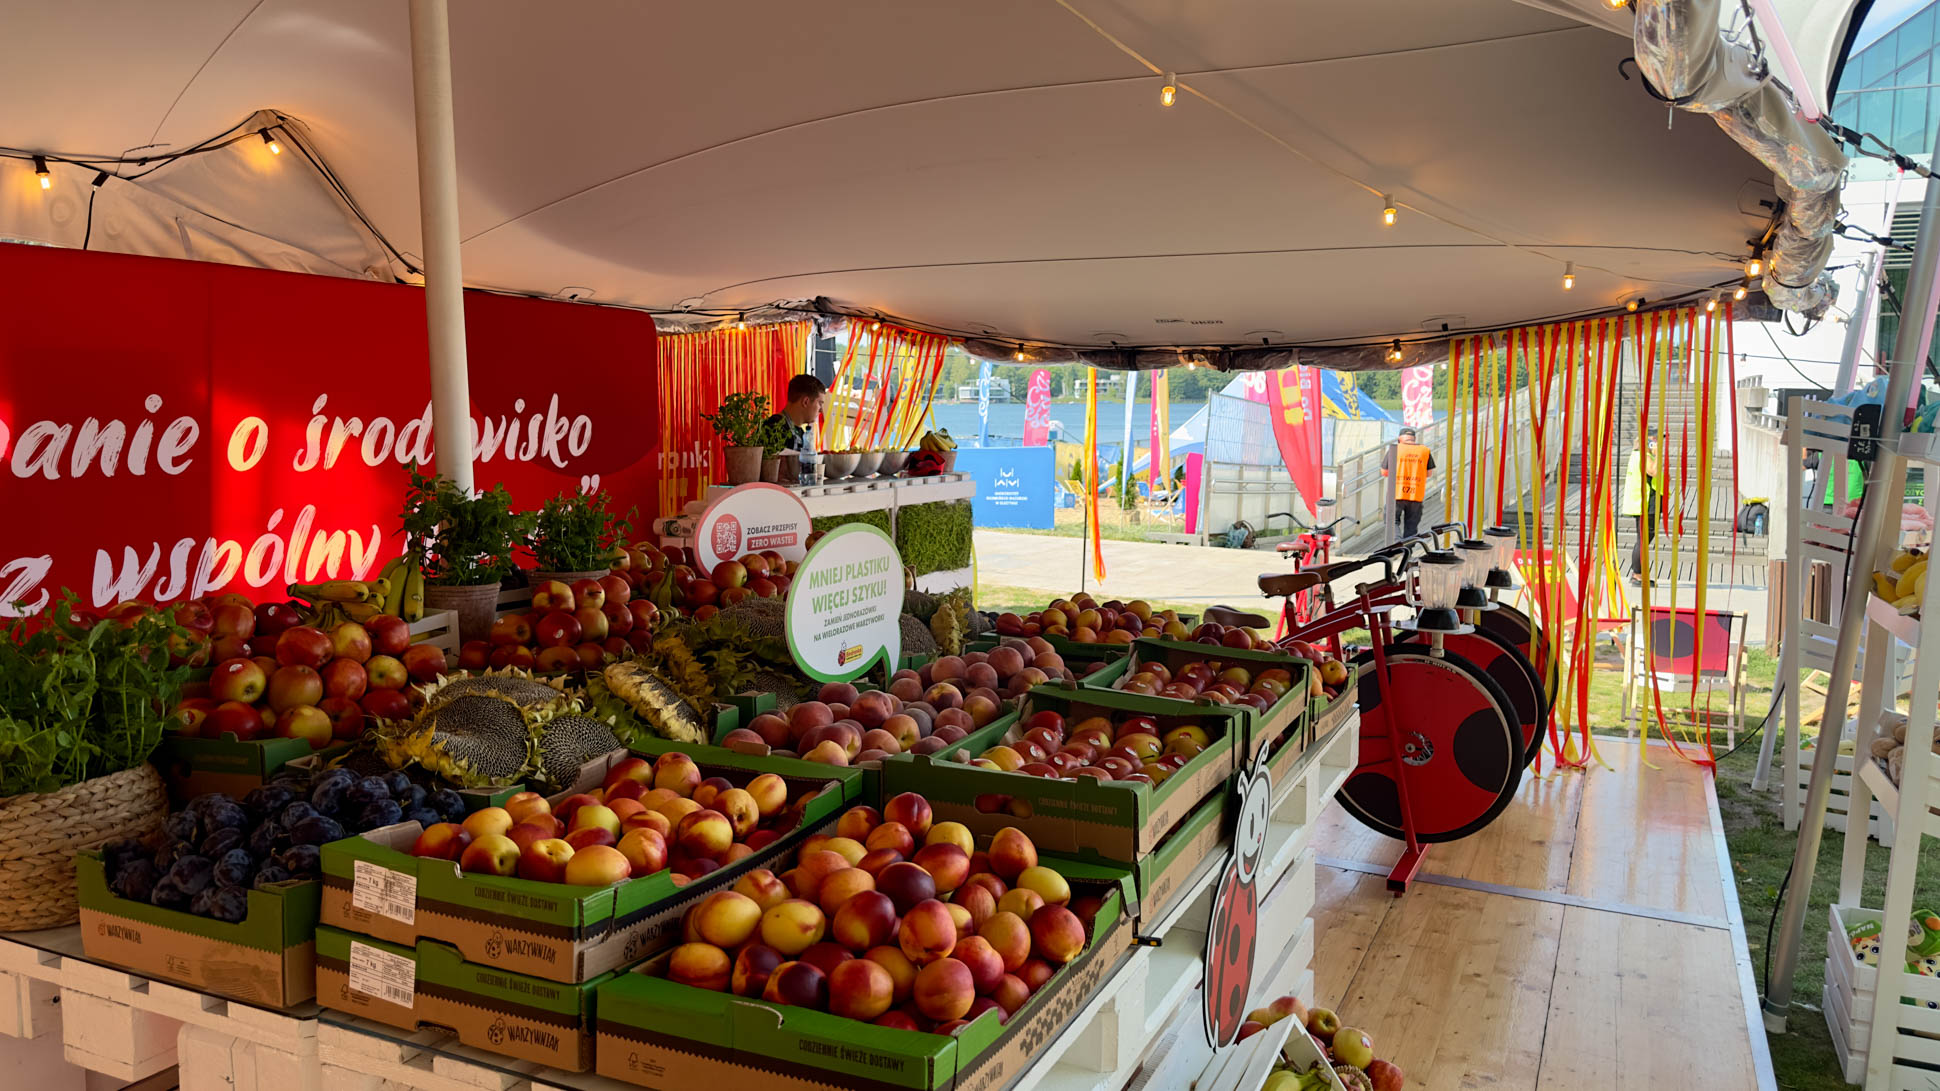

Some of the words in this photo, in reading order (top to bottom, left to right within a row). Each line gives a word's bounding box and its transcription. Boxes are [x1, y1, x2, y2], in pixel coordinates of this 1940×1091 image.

[0, 394, 200, 481] anie
[227, 416, 269, 472] o
[293, 392, 593, 472] środwisko
[746, 524, 771, 535] ZOBACZ
[772, 523, 798, 532] PRZEPISY
[751, 538, 769, 549] ZERO
[770, 536, 794, 546] WASTE!
[0, 554, 53, 618] z
[92, 504, 382, 609] wspólny
[809, 567, 843, 590] MNIEJ
[845, 555, 890, 582] PLASTIKU
[812, 591, 850, 614] WIĘCEJ
[852, 580, 887, 604] SZYKU!
[813, 631, 822, 642] NA
[822, 622, 856, 640] WIELORAZOWE
[474, 887, 505, 902] CODZIENNIE
[530, 897, 558, 912] DOSTAWY
[504, 937, 556, 964] WARZYWNIAK
[532, 984, 560, 1000] DOSTAWY
[507, 1026, 560, 1052] WARZYWNIAK
[799, 1039, 839, 1058] CODZIENNIE
[840, 1045, 867, 1065] ŚWIEŻE
[869, 1054, 904, 1072] DOSTAWY
